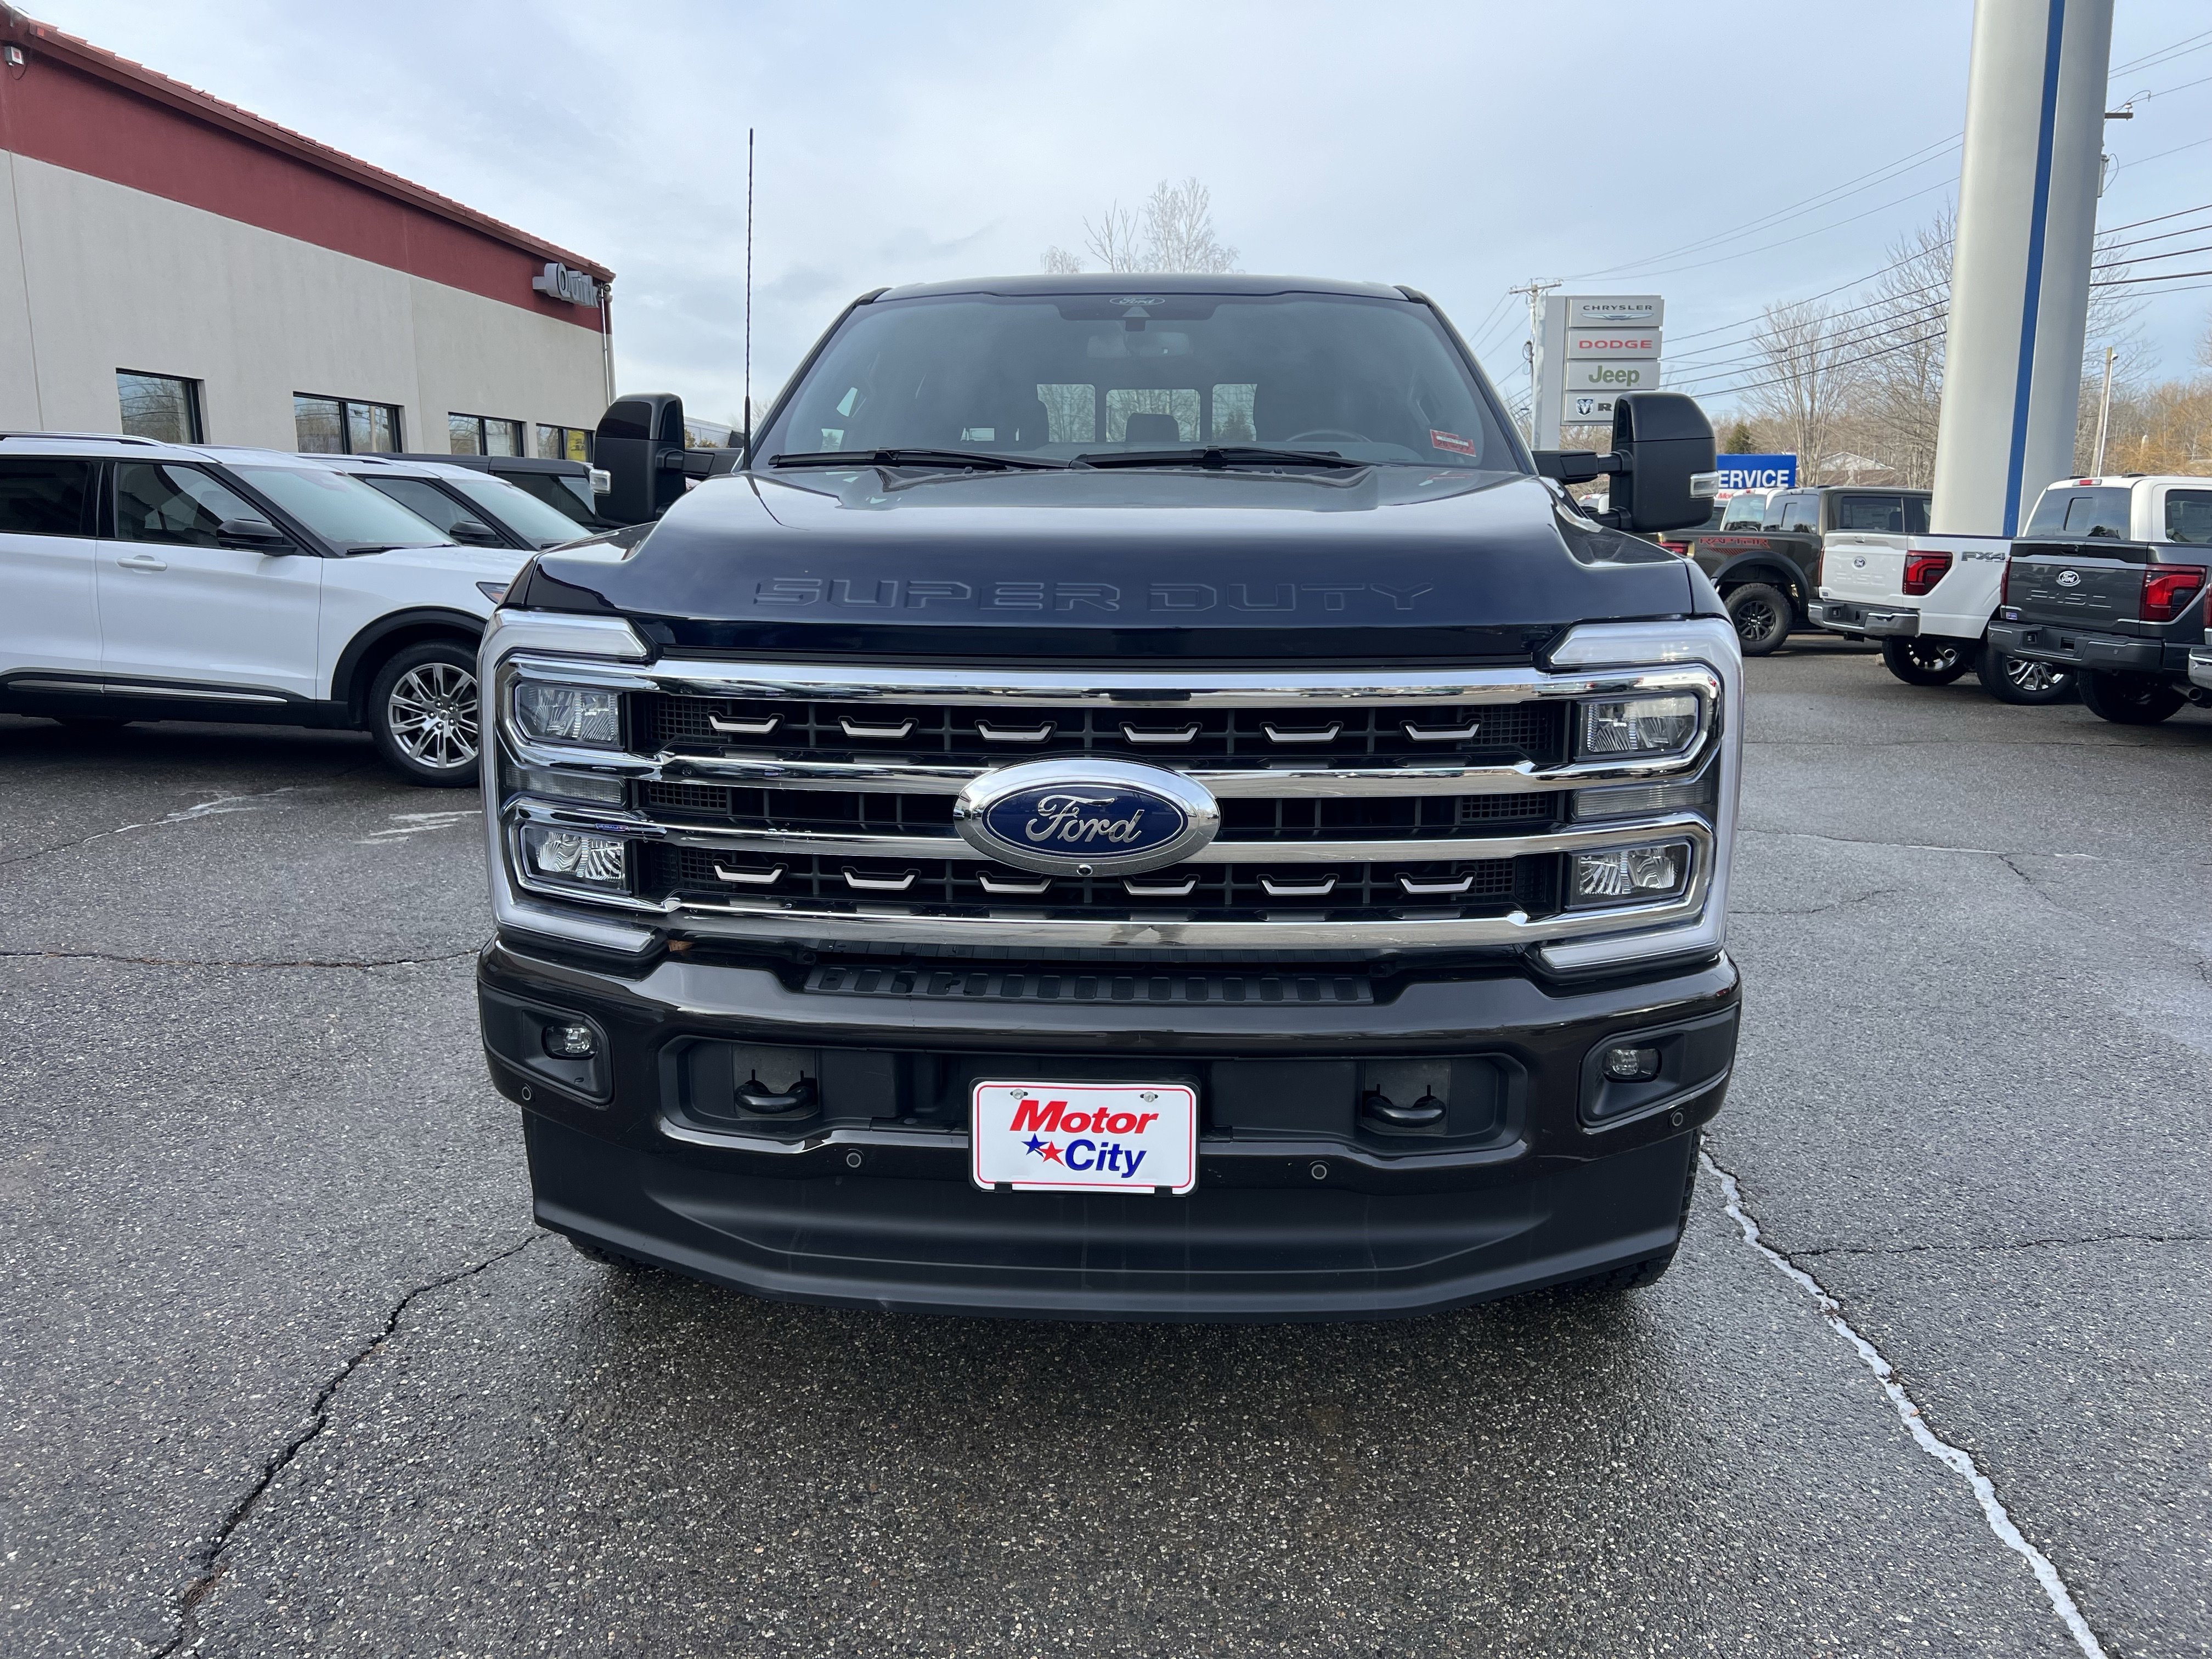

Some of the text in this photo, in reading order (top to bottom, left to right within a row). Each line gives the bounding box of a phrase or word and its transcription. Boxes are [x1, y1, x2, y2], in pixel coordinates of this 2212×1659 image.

[1579, 340, 1652, 348] DODGE
[1588, 365, 1640, 386] Jeep
[1718, 470, 1790, 488] ERVICE
[1699, 537, 1770, 549] RAPTOR
[1961, 551, 2005, 561] FX4
[753, 577, 1434, 611] SUPER DUTY
[1025, 794, 1145, 843] Ford
[1009, 1099, 1159, 1134] Motor
[1065, 1139, 1147, 1178] City
